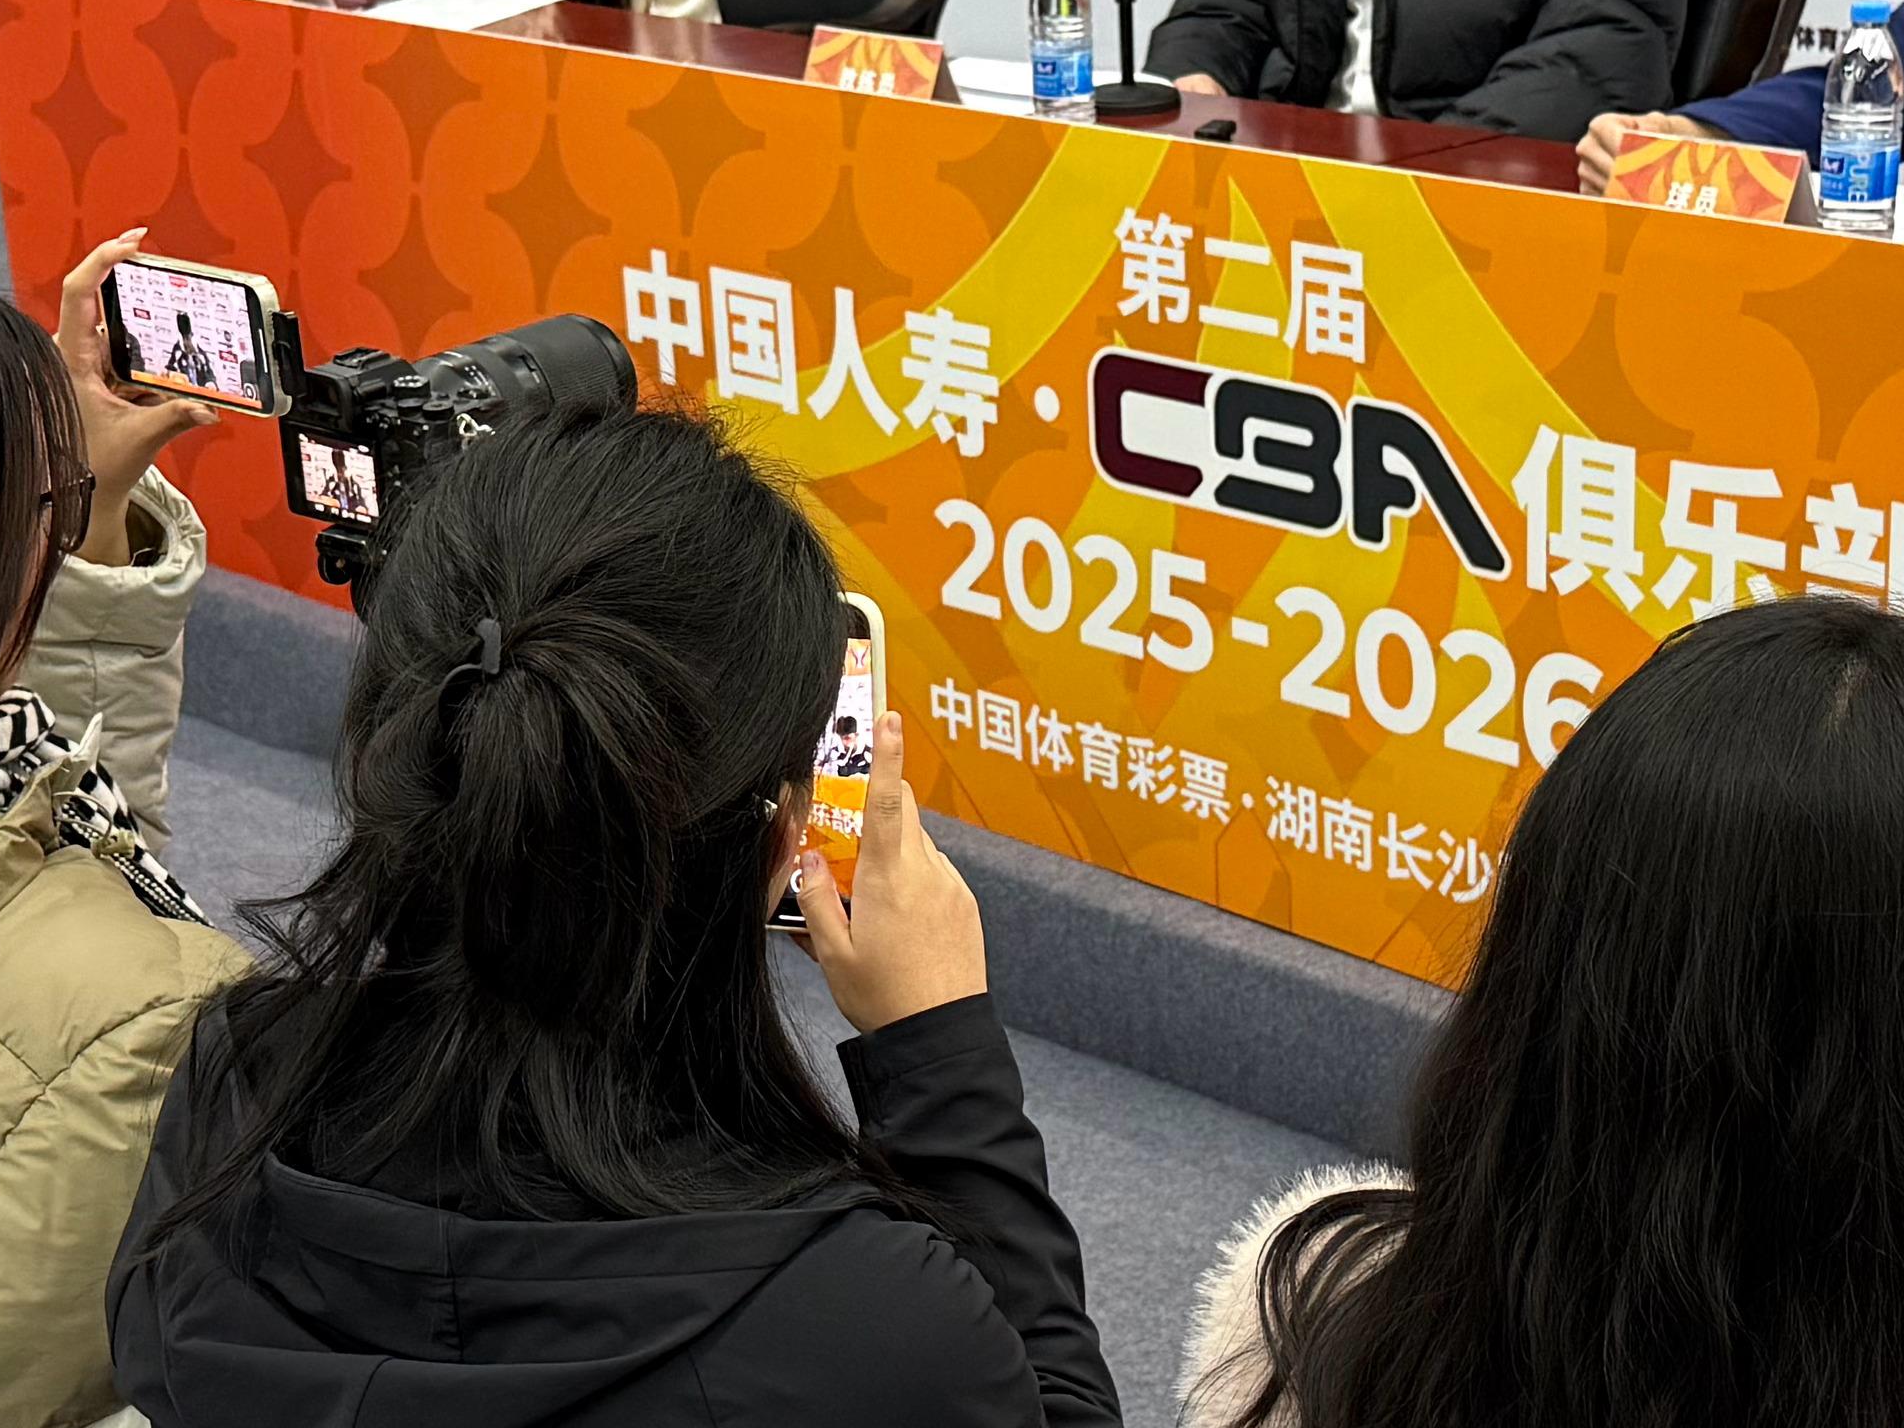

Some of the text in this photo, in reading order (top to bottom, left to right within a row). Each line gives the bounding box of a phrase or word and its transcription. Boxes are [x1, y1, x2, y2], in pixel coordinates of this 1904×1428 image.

[1113, 208, 1366, 363] 第二届
[934, 498, 1606, 772] 2025-2026
[930, 678, 1502, 905] 中国体育彩票·湖南长沙
